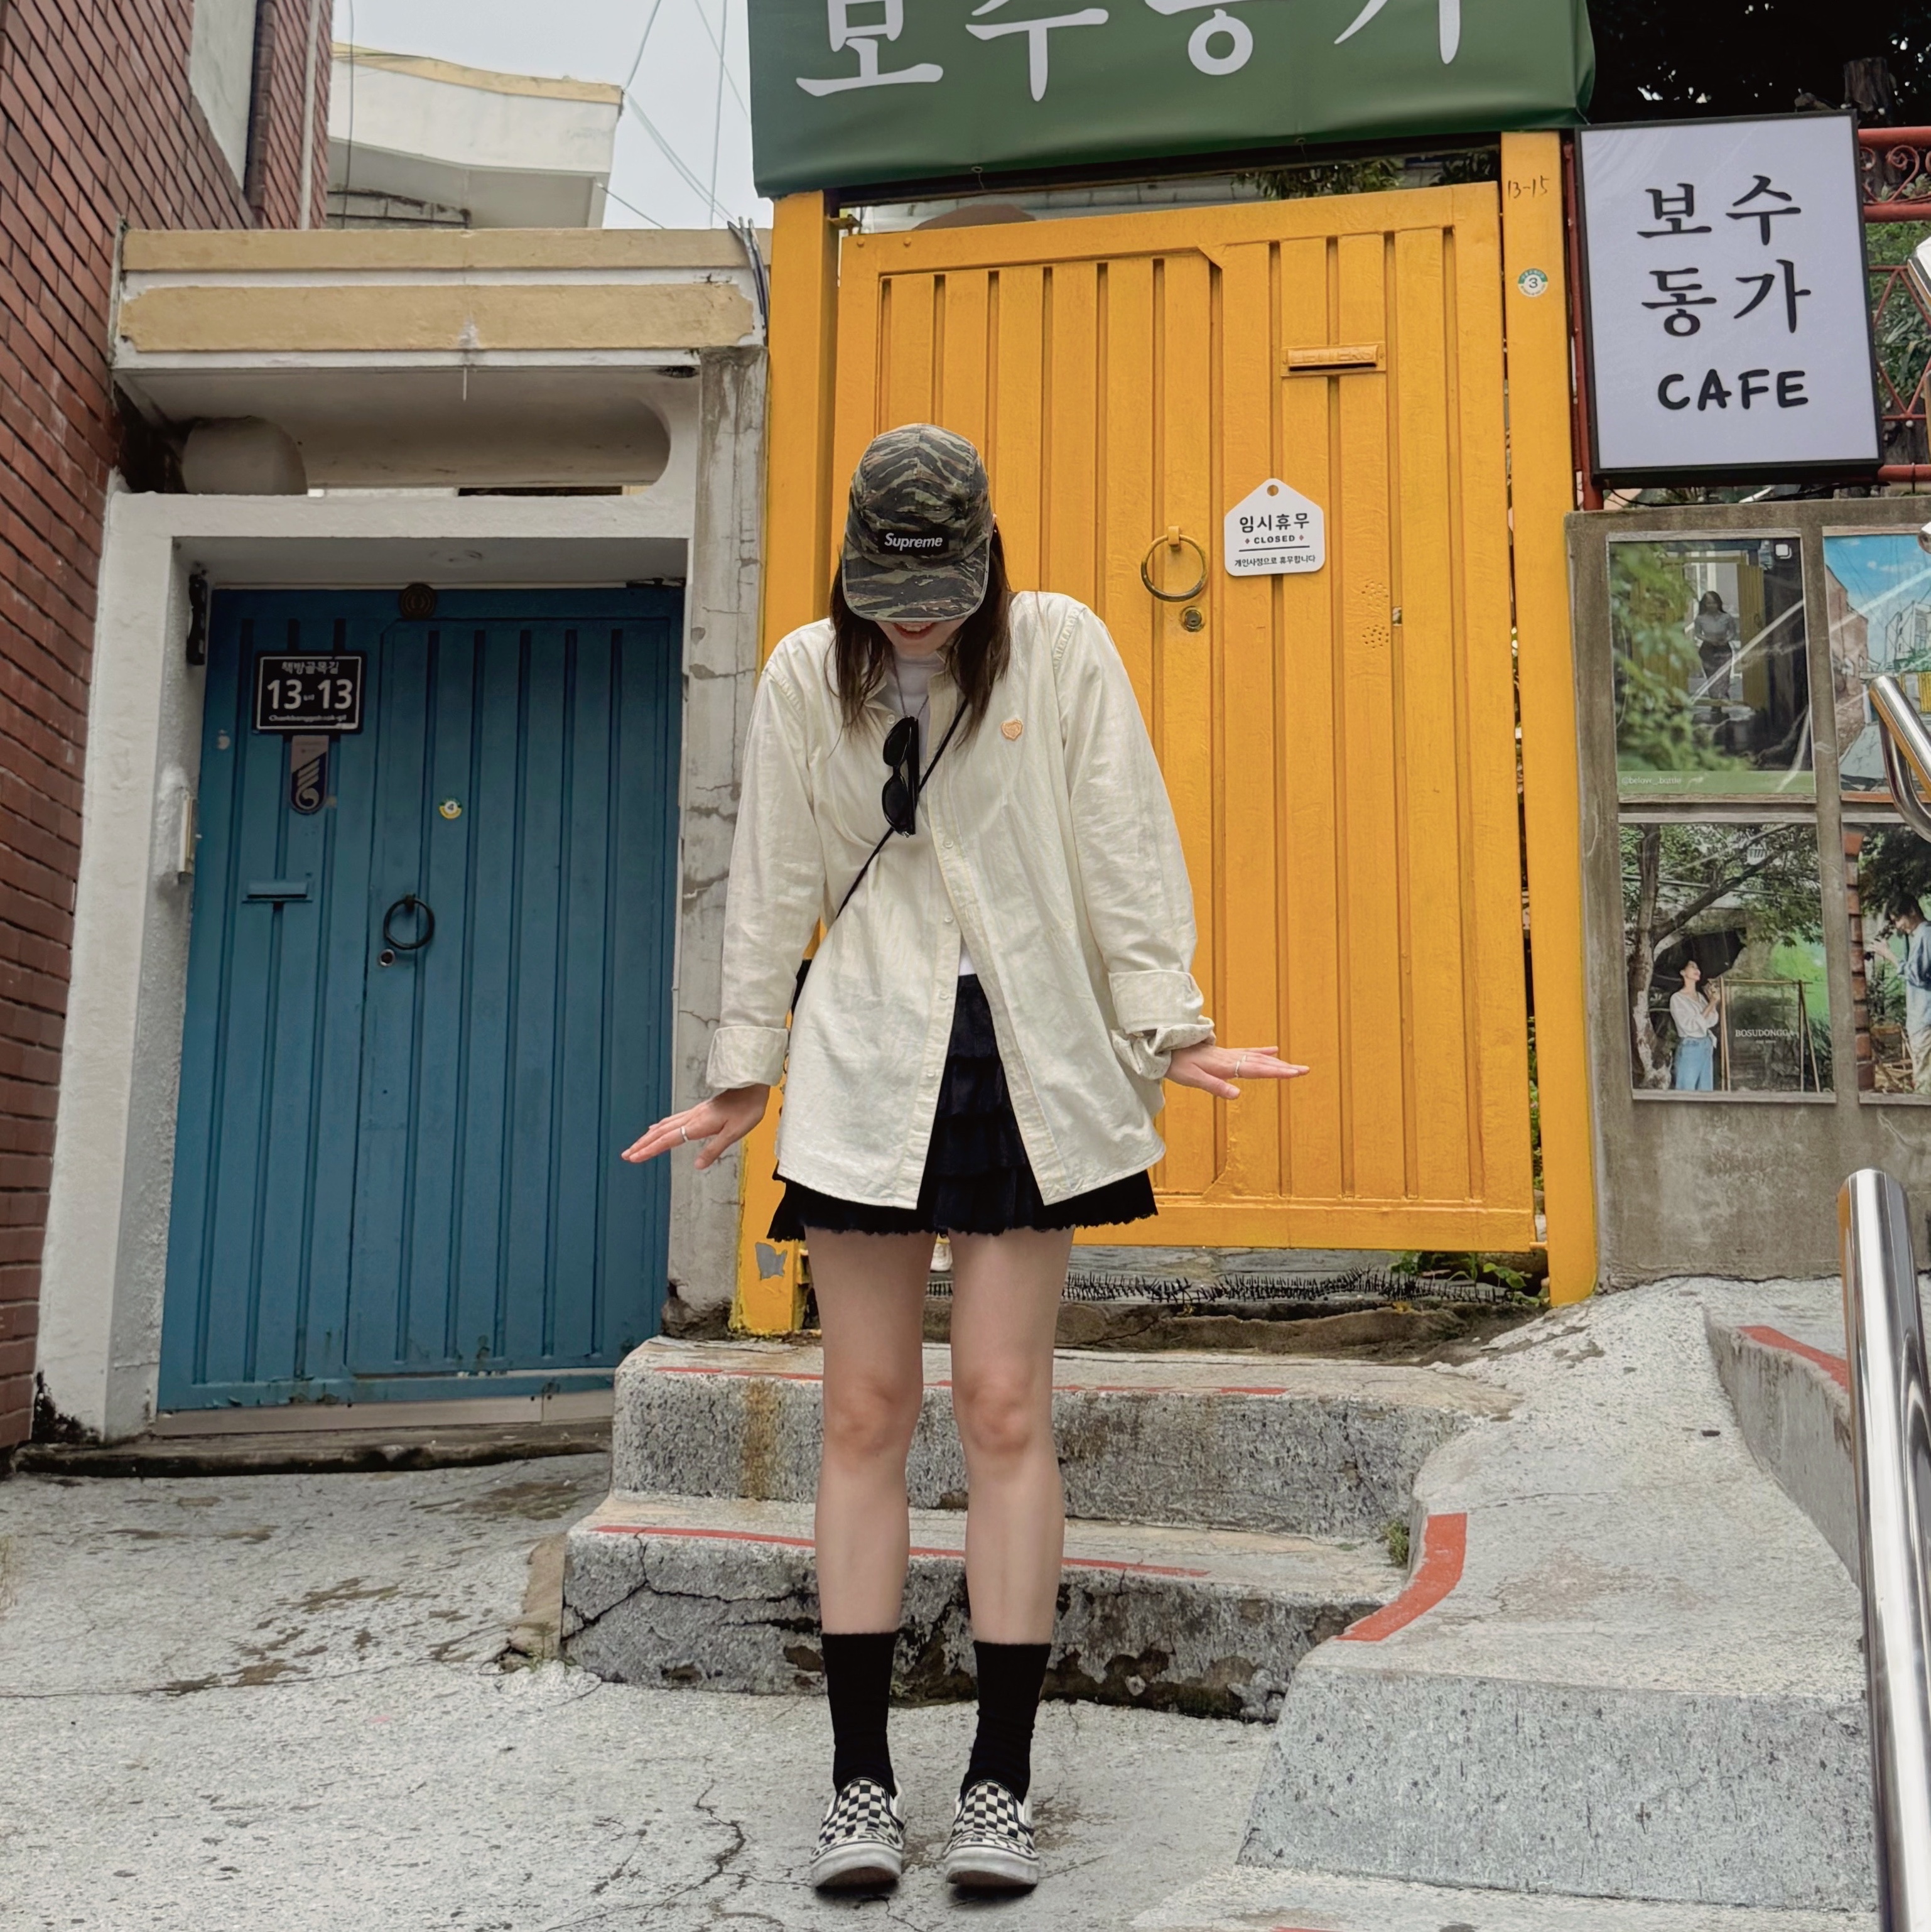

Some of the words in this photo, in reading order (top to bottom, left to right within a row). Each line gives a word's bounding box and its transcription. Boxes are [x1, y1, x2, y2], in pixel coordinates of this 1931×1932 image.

[1508, 175, 1549, 198] 13-15
[1528, 277, 1538, 288] 3
[1658, 369, 1808, 411] CAFE
[1240, 513, 1309, 533] 임시휴무
[884, 533, 943, 551] Supreme
[1253, 535, 1295, 544] CLOSED
[1235, 556, 1277, 567] 개인사정으로
[267, 679, 353, 709] 13-13
